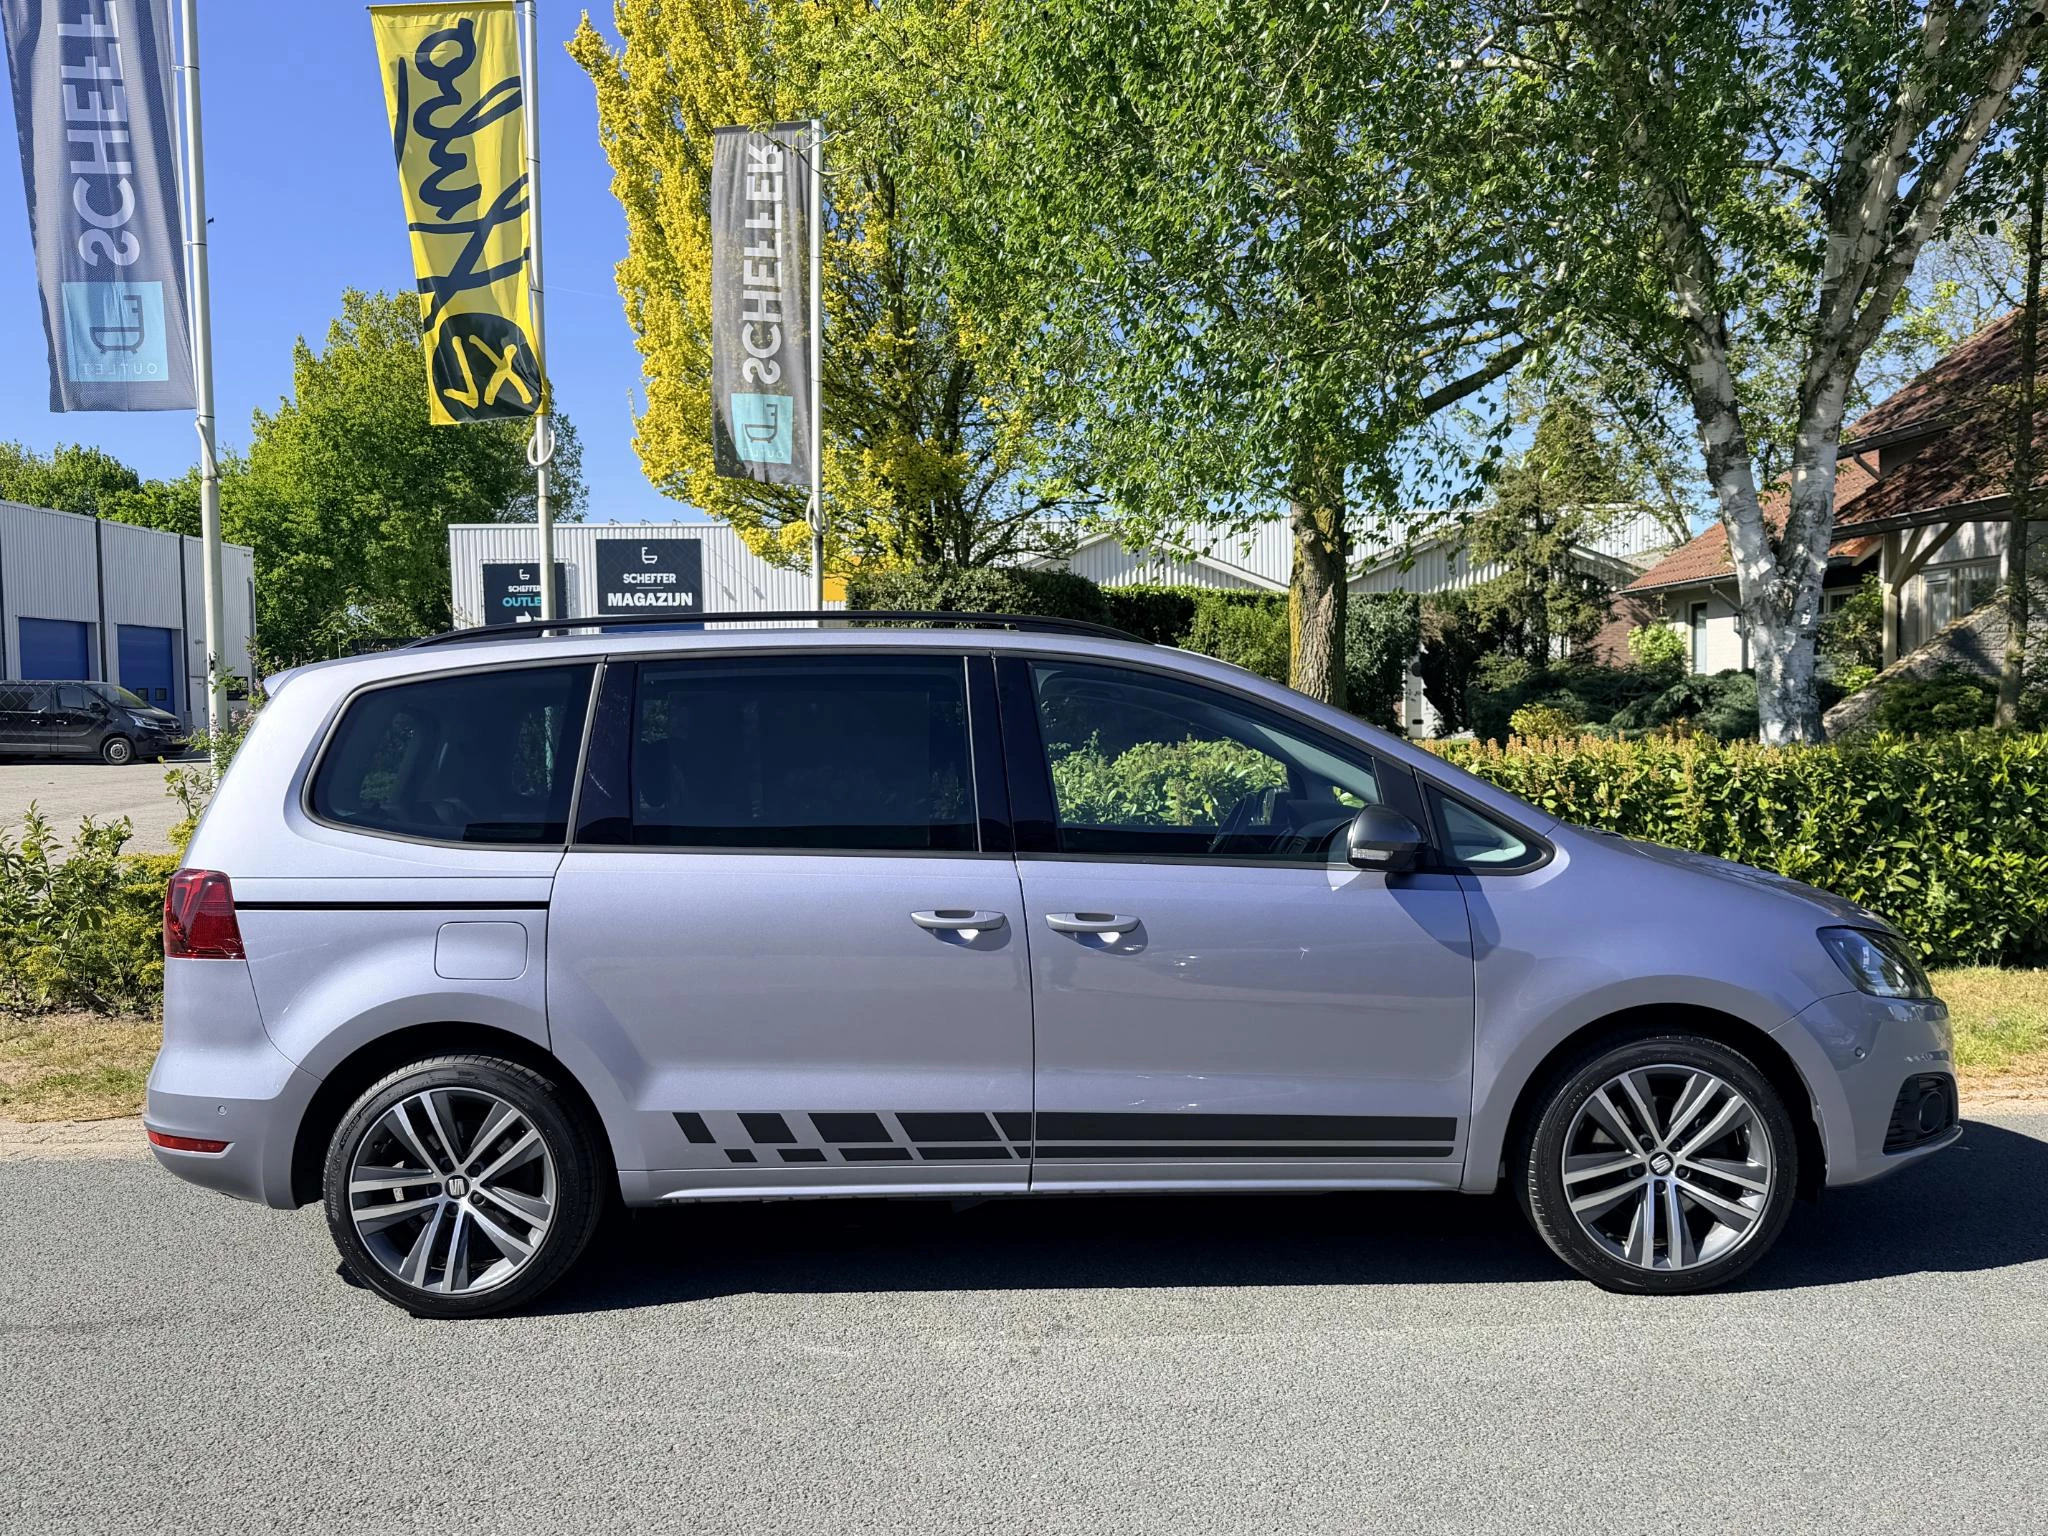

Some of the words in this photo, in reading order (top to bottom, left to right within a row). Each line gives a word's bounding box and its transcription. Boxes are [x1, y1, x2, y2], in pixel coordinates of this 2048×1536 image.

[622, 573, 677, 584] SCHEFFER
[502, 596, 541, 607] OUTLE
[607, 592, 693, 607] MAGAZIJN
